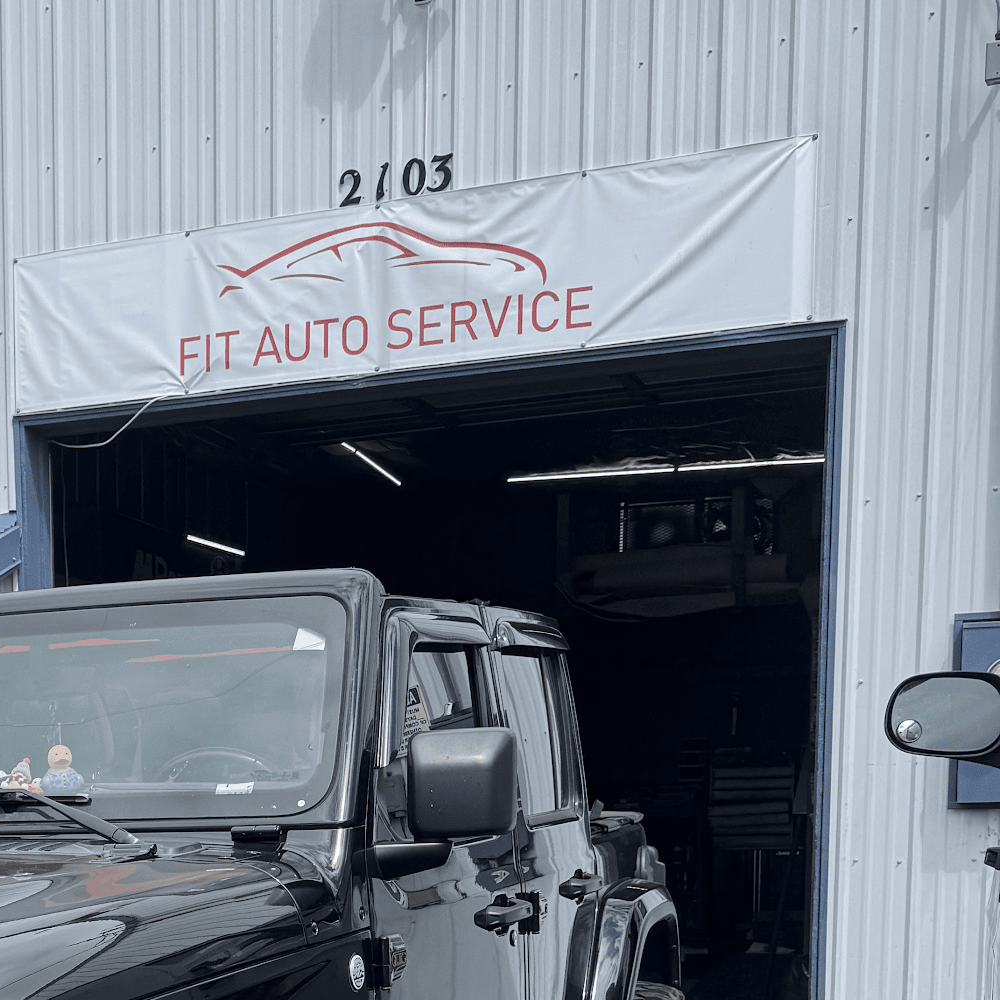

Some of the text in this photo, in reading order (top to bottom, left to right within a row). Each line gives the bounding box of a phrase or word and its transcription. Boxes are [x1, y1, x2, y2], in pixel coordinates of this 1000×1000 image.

[338, 153, 454, 207] 2103
[180, 285, 593, 376] FIT AUTO SERVICE
